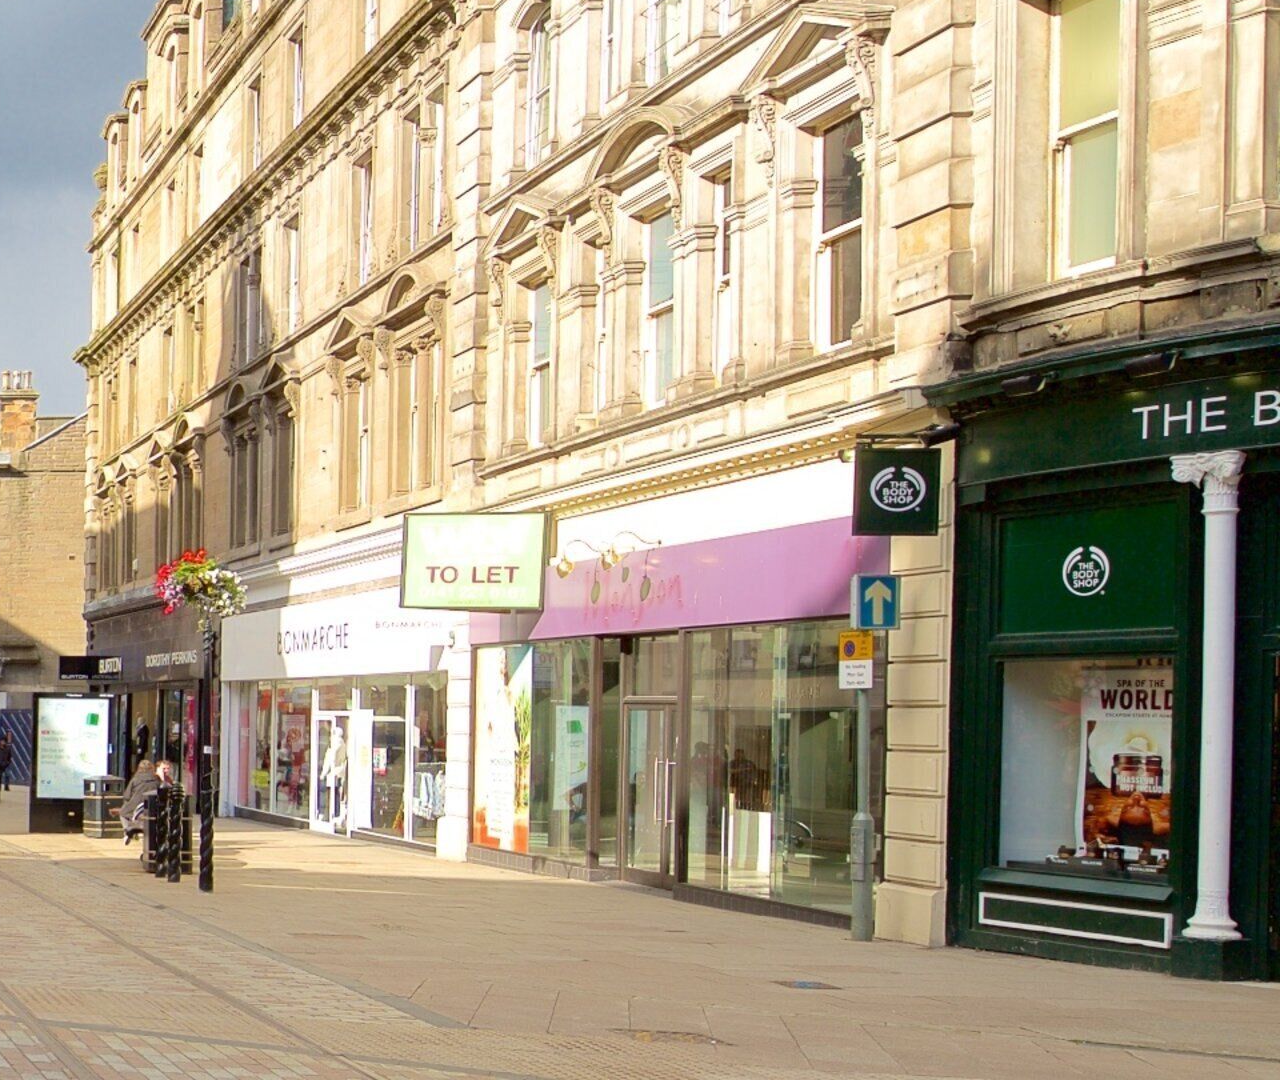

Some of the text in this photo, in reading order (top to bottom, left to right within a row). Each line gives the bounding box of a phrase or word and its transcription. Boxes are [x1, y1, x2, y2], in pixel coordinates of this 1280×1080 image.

[1132, 395, 1227, 439] THE
[889, 481, 909, 489] THE
[882, 488, 914, 496] BODY
[883, 496, 914, 504] SHOP
[1077, 561, 1095, 570] THE
[426, 566, 519, 583] TO LET
[1072, 569, 1100, 579] BODY
[1073, 578, 1100, 588] SHOP
[276, 623, 349, 656] BONMARCHE
[145, 650, 198, 668] DOROTHY PERKINS
[99, 657, 122, 674] BURTON
[1116, 680, 1132, 688] SPA
